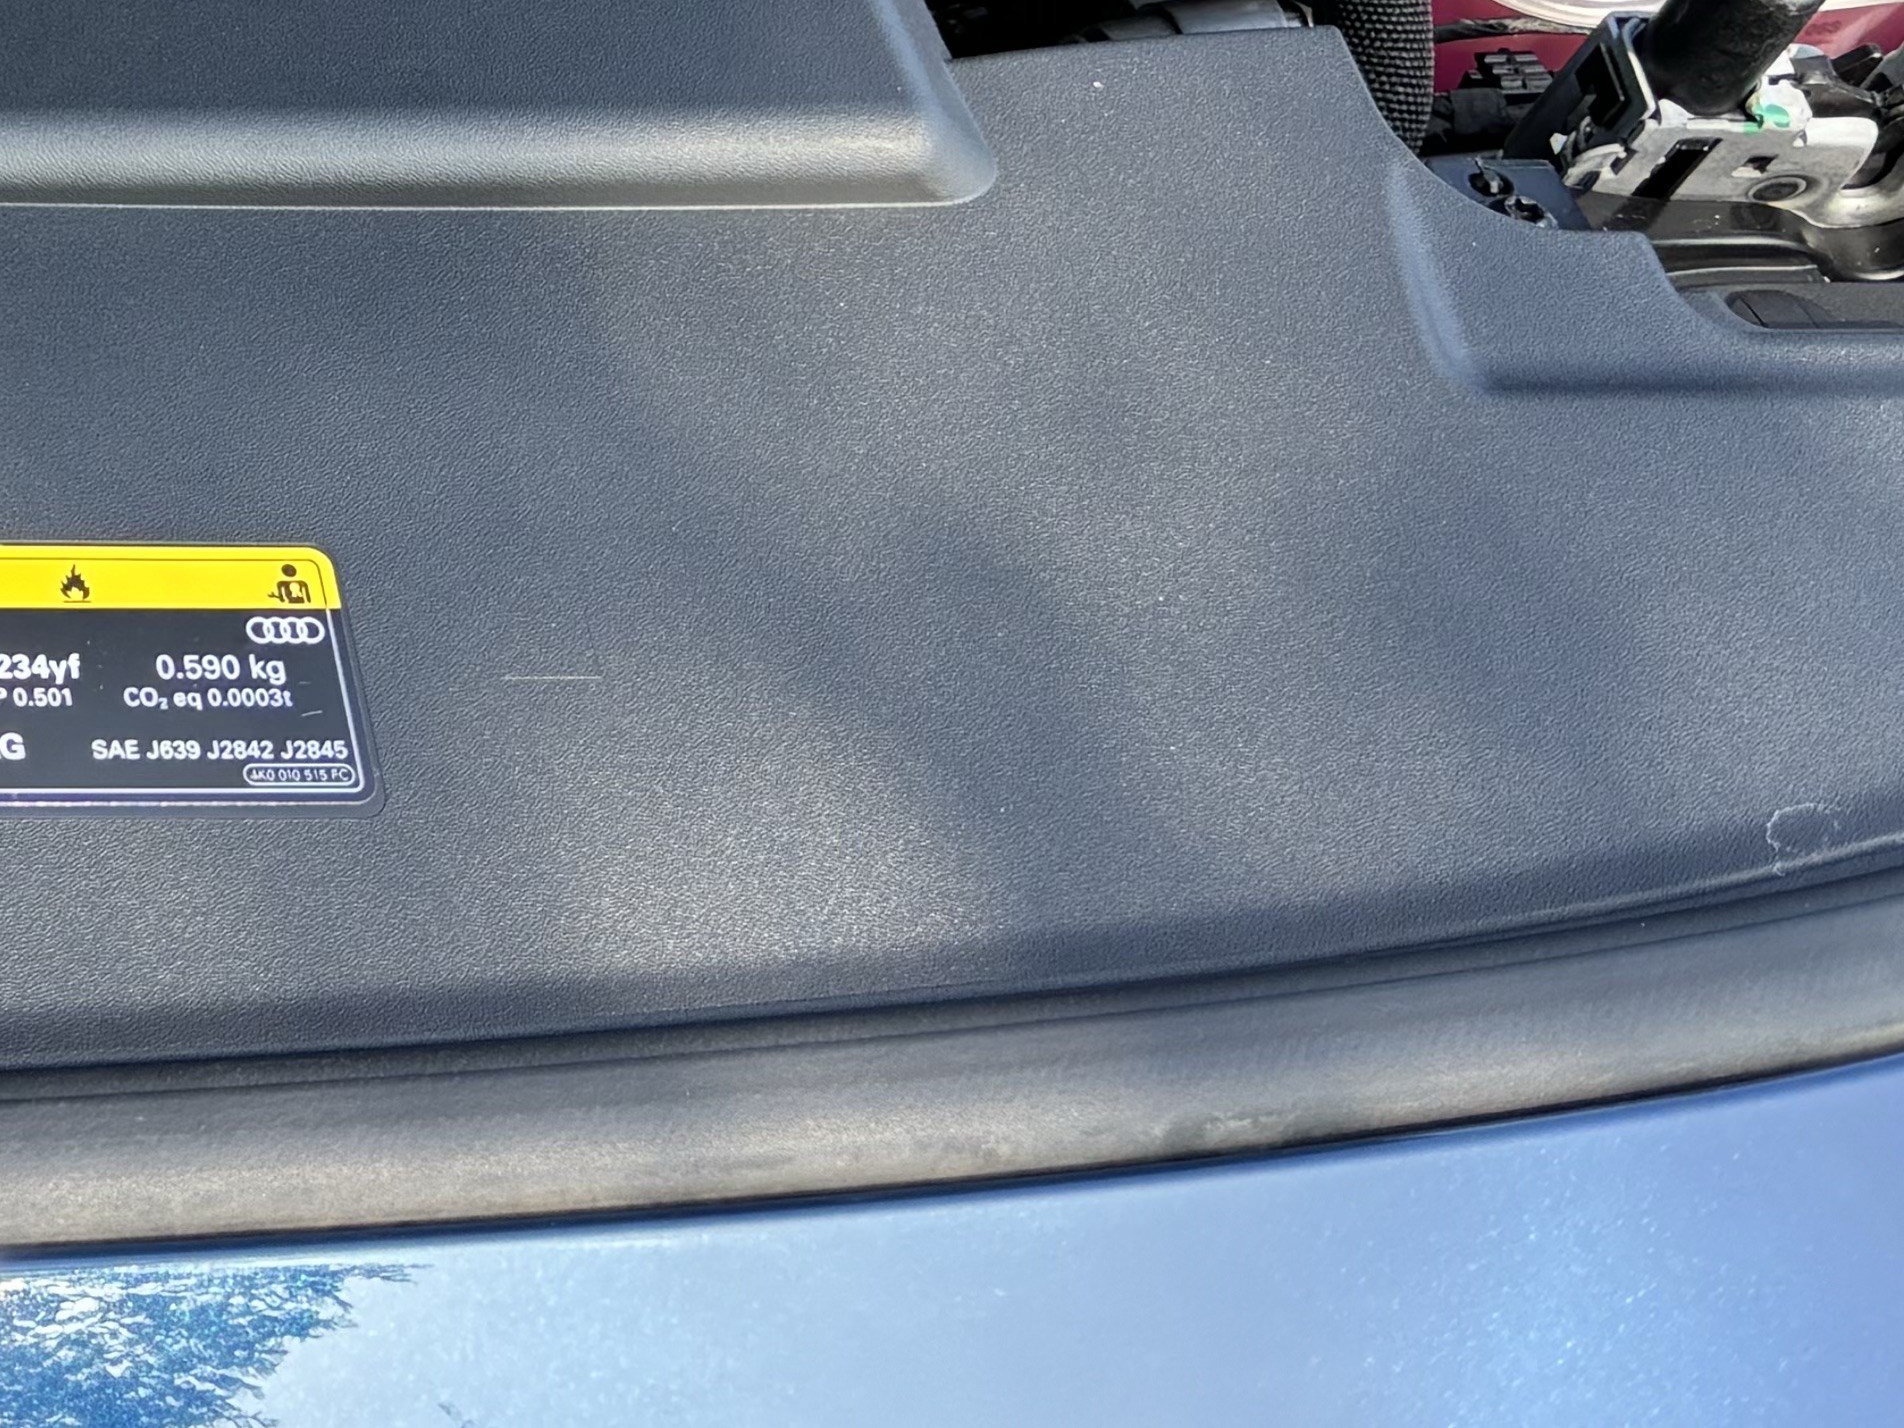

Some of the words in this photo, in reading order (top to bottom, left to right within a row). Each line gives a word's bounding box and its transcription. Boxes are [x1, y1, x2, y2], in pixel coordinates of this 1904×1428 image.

[155, 654, 241, 680] 0.590
[248, 653, 287, 686] kg
[12, 687, 73, 707] 0.501
[173, 692, 203, 711] eq
[207, 687, 293, 707] 0.0003t
[91, 739, 141, 760] SAE
[146, 740, 201, 760] J639
[206, 740, 275, 760] J2842
[280, 740, 349, 760] J2845
